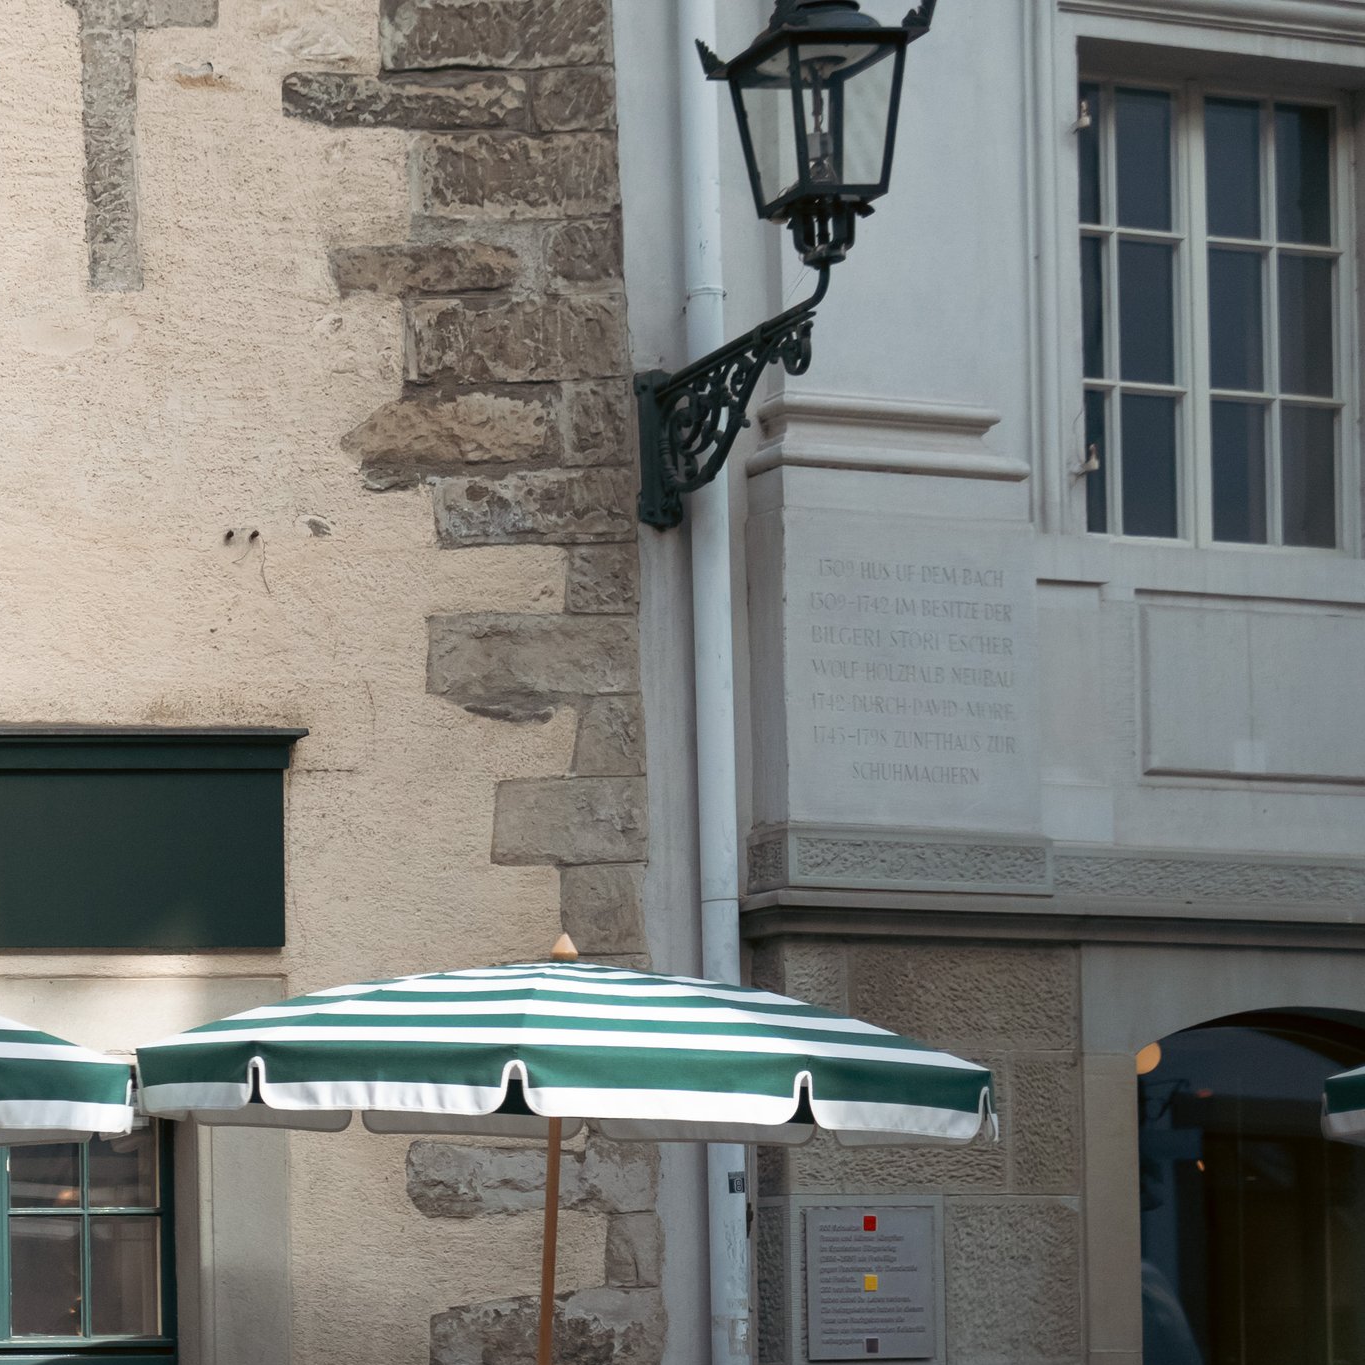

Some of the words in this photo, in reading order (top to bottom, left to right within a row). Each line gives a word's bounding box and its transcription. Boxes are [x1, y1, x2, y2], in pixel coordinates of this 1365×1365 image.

[861, 560, 890, 580] HUS
[922, 565, 957, 586] DEM
[962, 567, 1004, 588] BACH
[895, 596, 917, 616] IM
[921, 598, 979, 619] BESITZE
[983, 602, 1012, 623] DER
[810, 625, 881, 648] BILGERI
[947, 633, 1014, 656] ESCHER
[810, 658, 859, 680] WOLF
[865, 661, 946, 684] HOLZHALB
[951, 666, 1015, 688] NEUBAU
[852, 694, 907, 715] DURCH
[913, 698, 957, 718] DAVID
[893, 729, 982, 753] ZUNFTHAUS
[986, 734, 1016, 755] ZUR
[851, 762, 981, 785] SCHUHMACHERN
